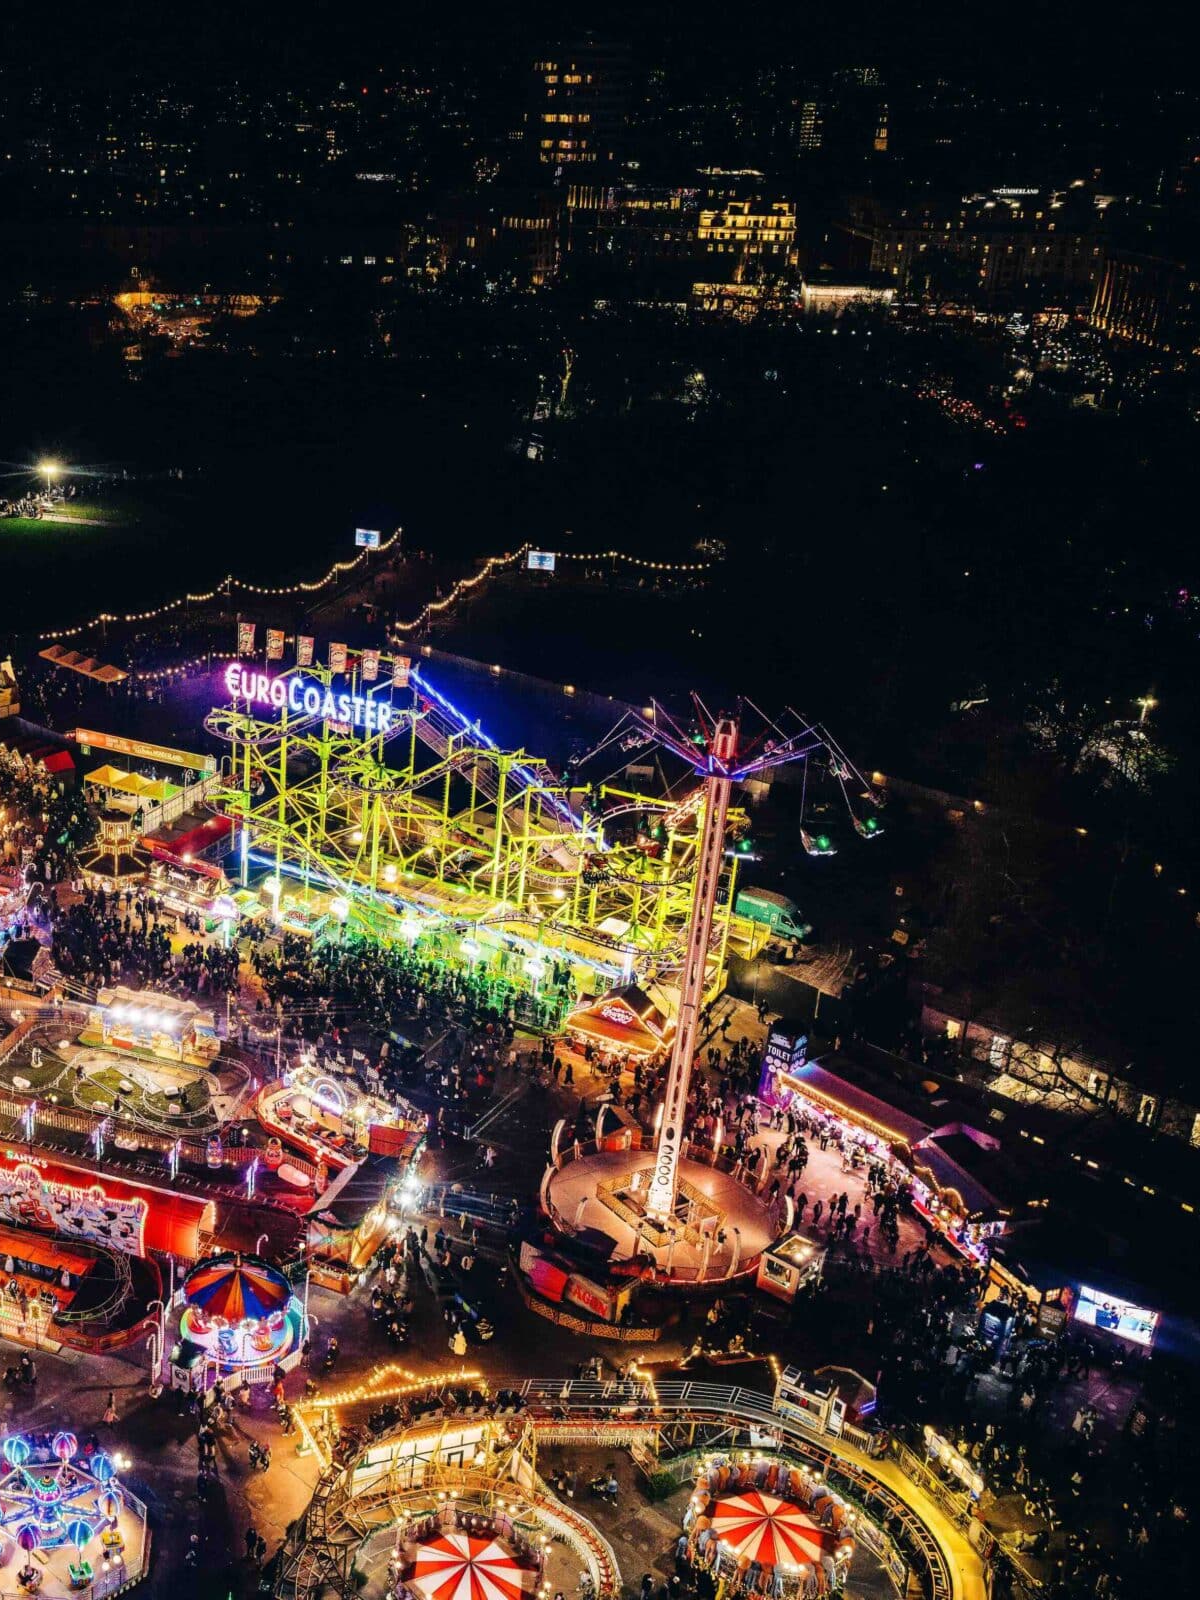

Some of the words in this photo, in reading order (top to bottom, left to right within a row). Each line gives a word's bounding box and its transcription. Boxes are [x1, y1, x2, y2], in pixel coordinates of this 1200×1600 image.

[768, 1044, 791, 1062] TOILET
[6, 1150, 49, 1169] SANTA'S
[42, 1183, 83, 1202] TRAIN
